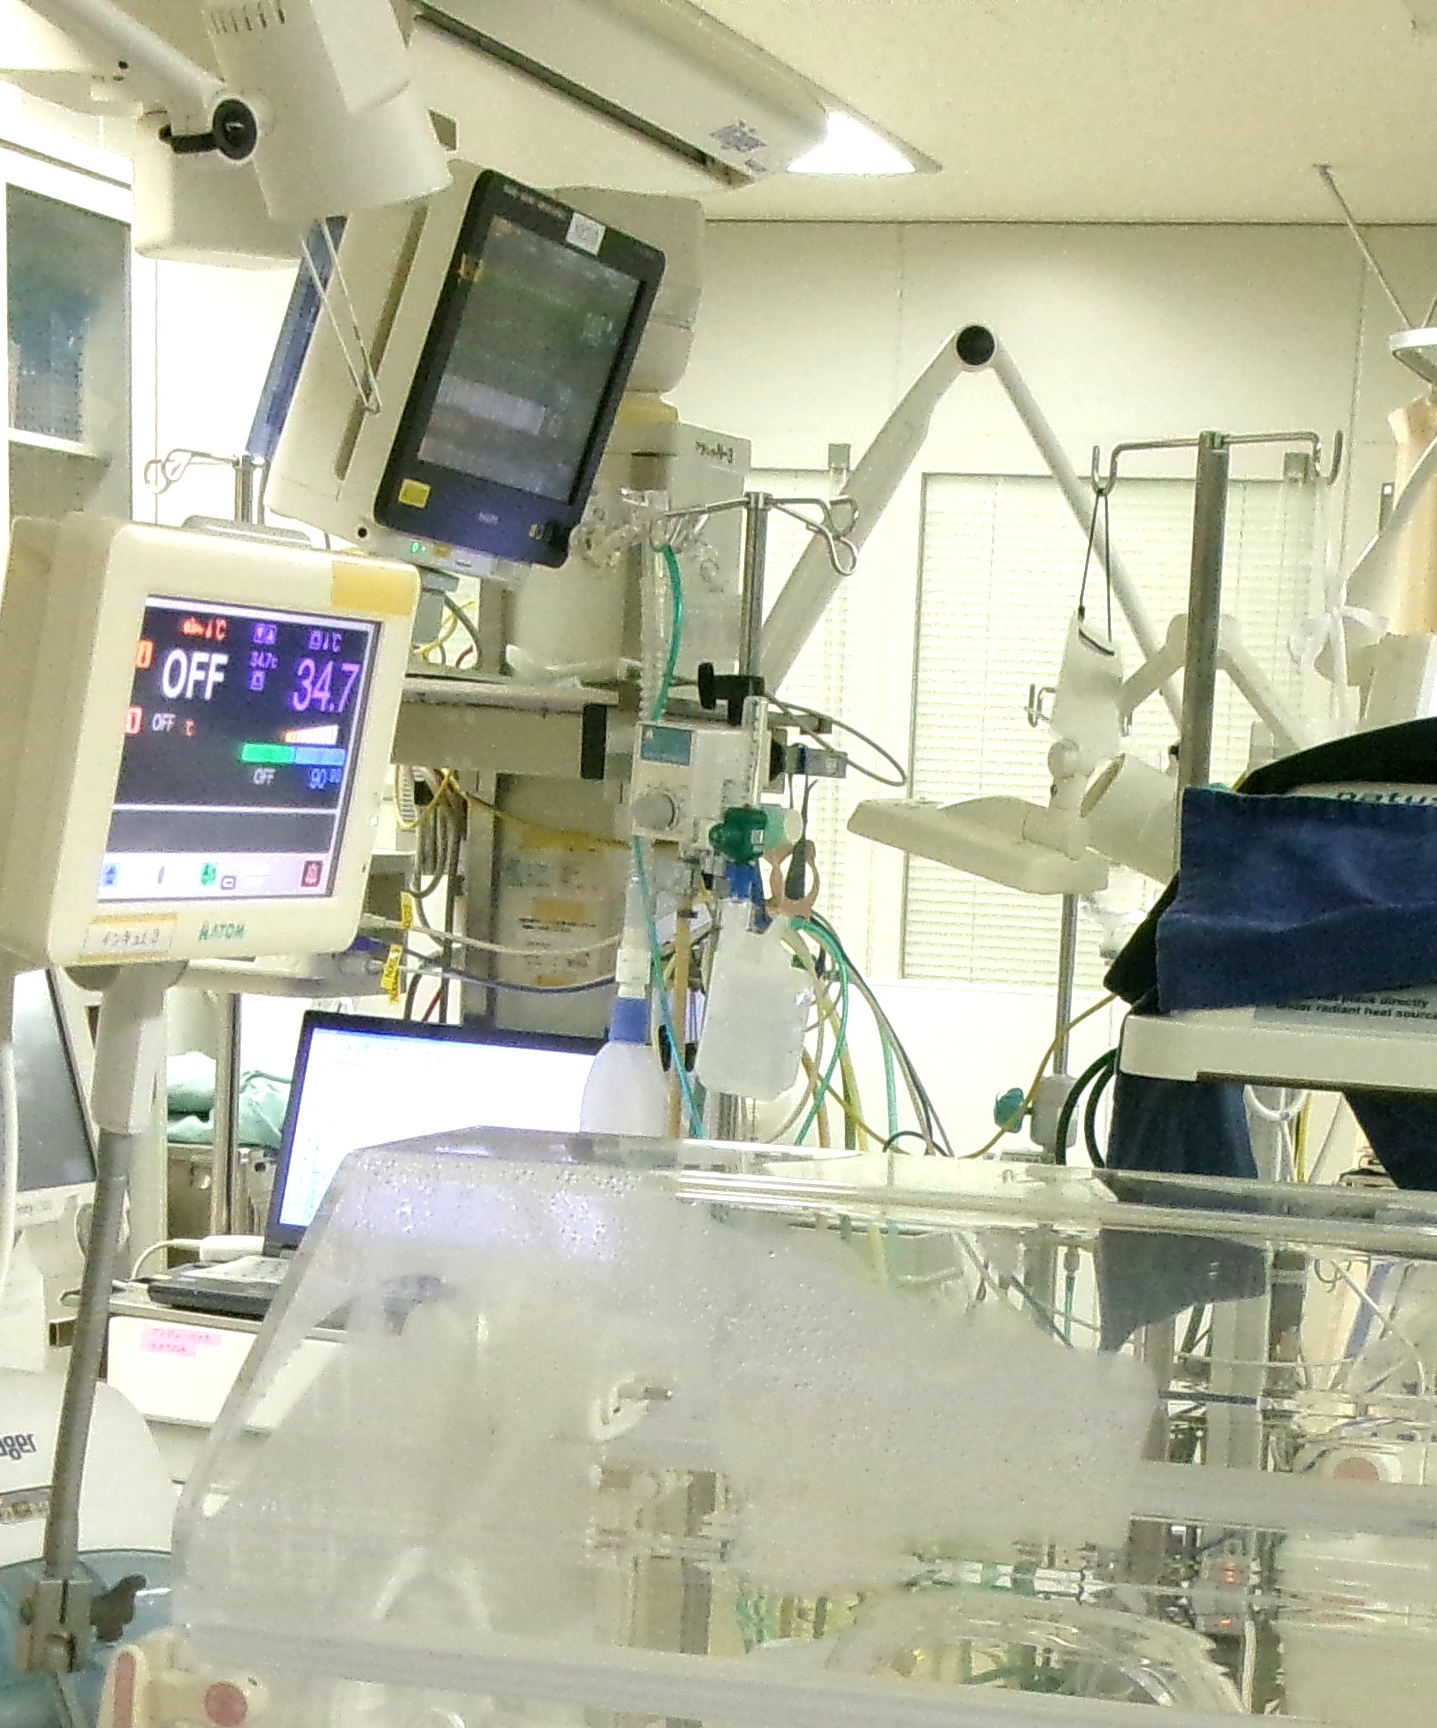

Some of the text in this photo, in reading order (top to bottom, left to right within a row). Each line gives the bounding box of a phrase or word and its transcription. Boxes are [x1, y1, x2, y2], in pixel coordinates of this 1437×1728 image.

[162, 649, 229, 700] OFF
[292, 657, 360, 713] 34.7
[152, 713, 175, 732] OFF
[253, 768, 276, 786] OFF
[1317, 1002, 1361, 1016] radiant
[1364, 1005, 1392, 1018] heat
